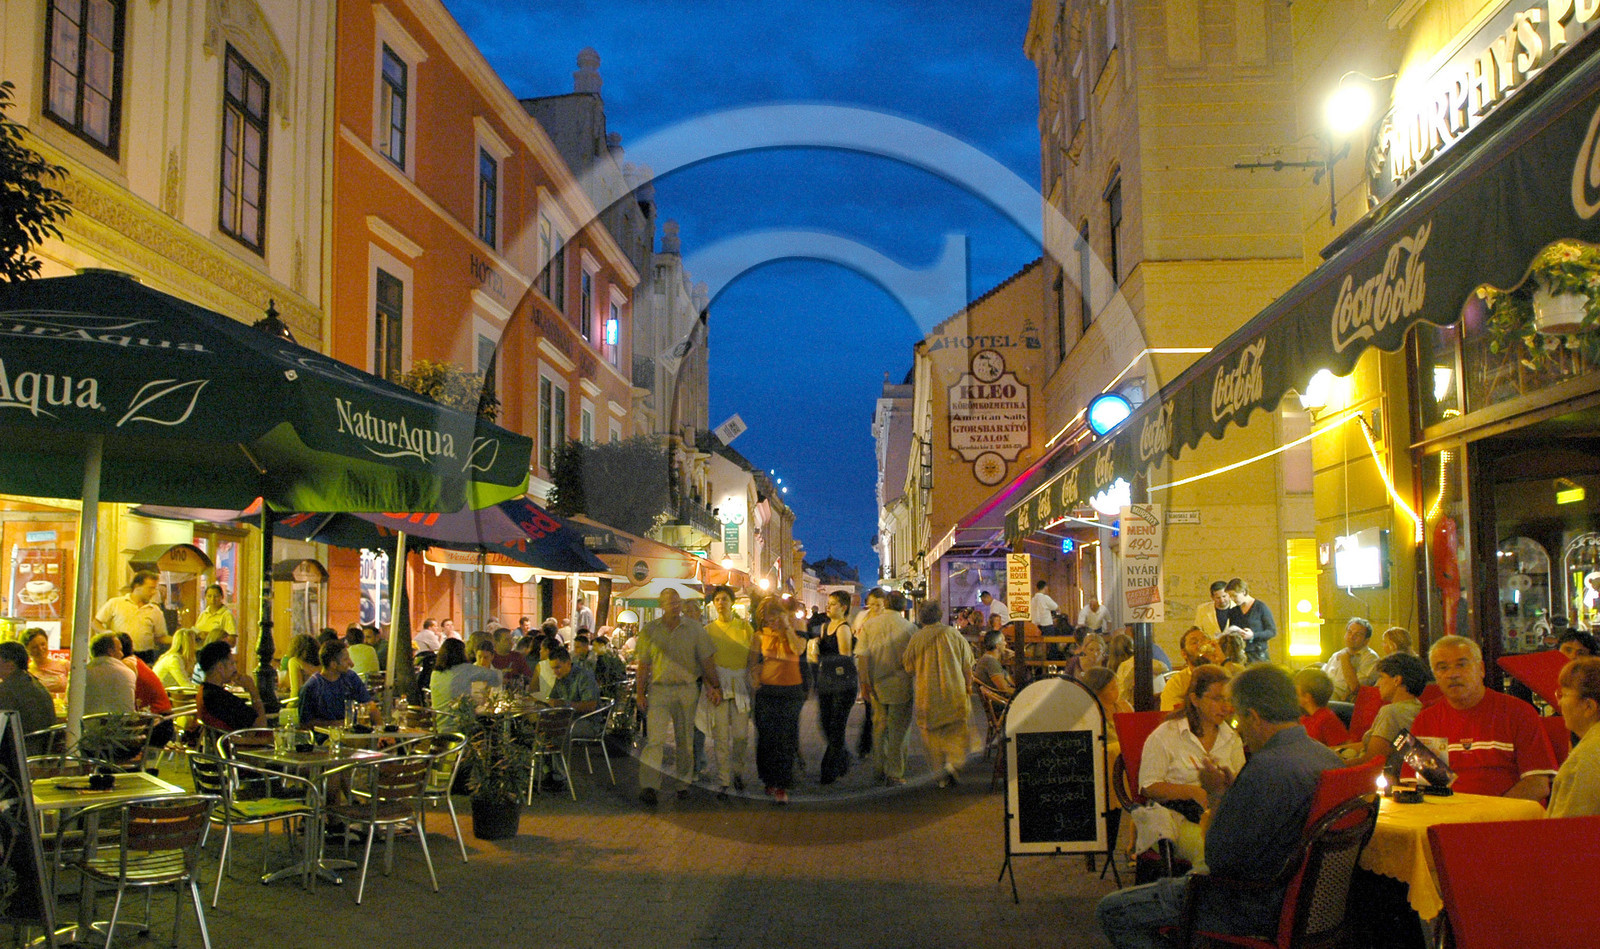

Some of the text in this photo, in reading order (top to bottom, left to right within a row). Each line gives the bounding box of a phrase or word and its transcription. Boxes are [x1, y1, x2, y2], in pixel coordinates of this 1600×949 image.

[470, 253, 506, 299] HOTEL
[944, 335, 1018, 349] HOTEL
[960, 384, 1017, 399] KLEO
[335, 397, 456, 464] NaturAqua
[970, 434, 1010, 442] SZALON
[1126, 563, 1159, 575] NYÁRI
